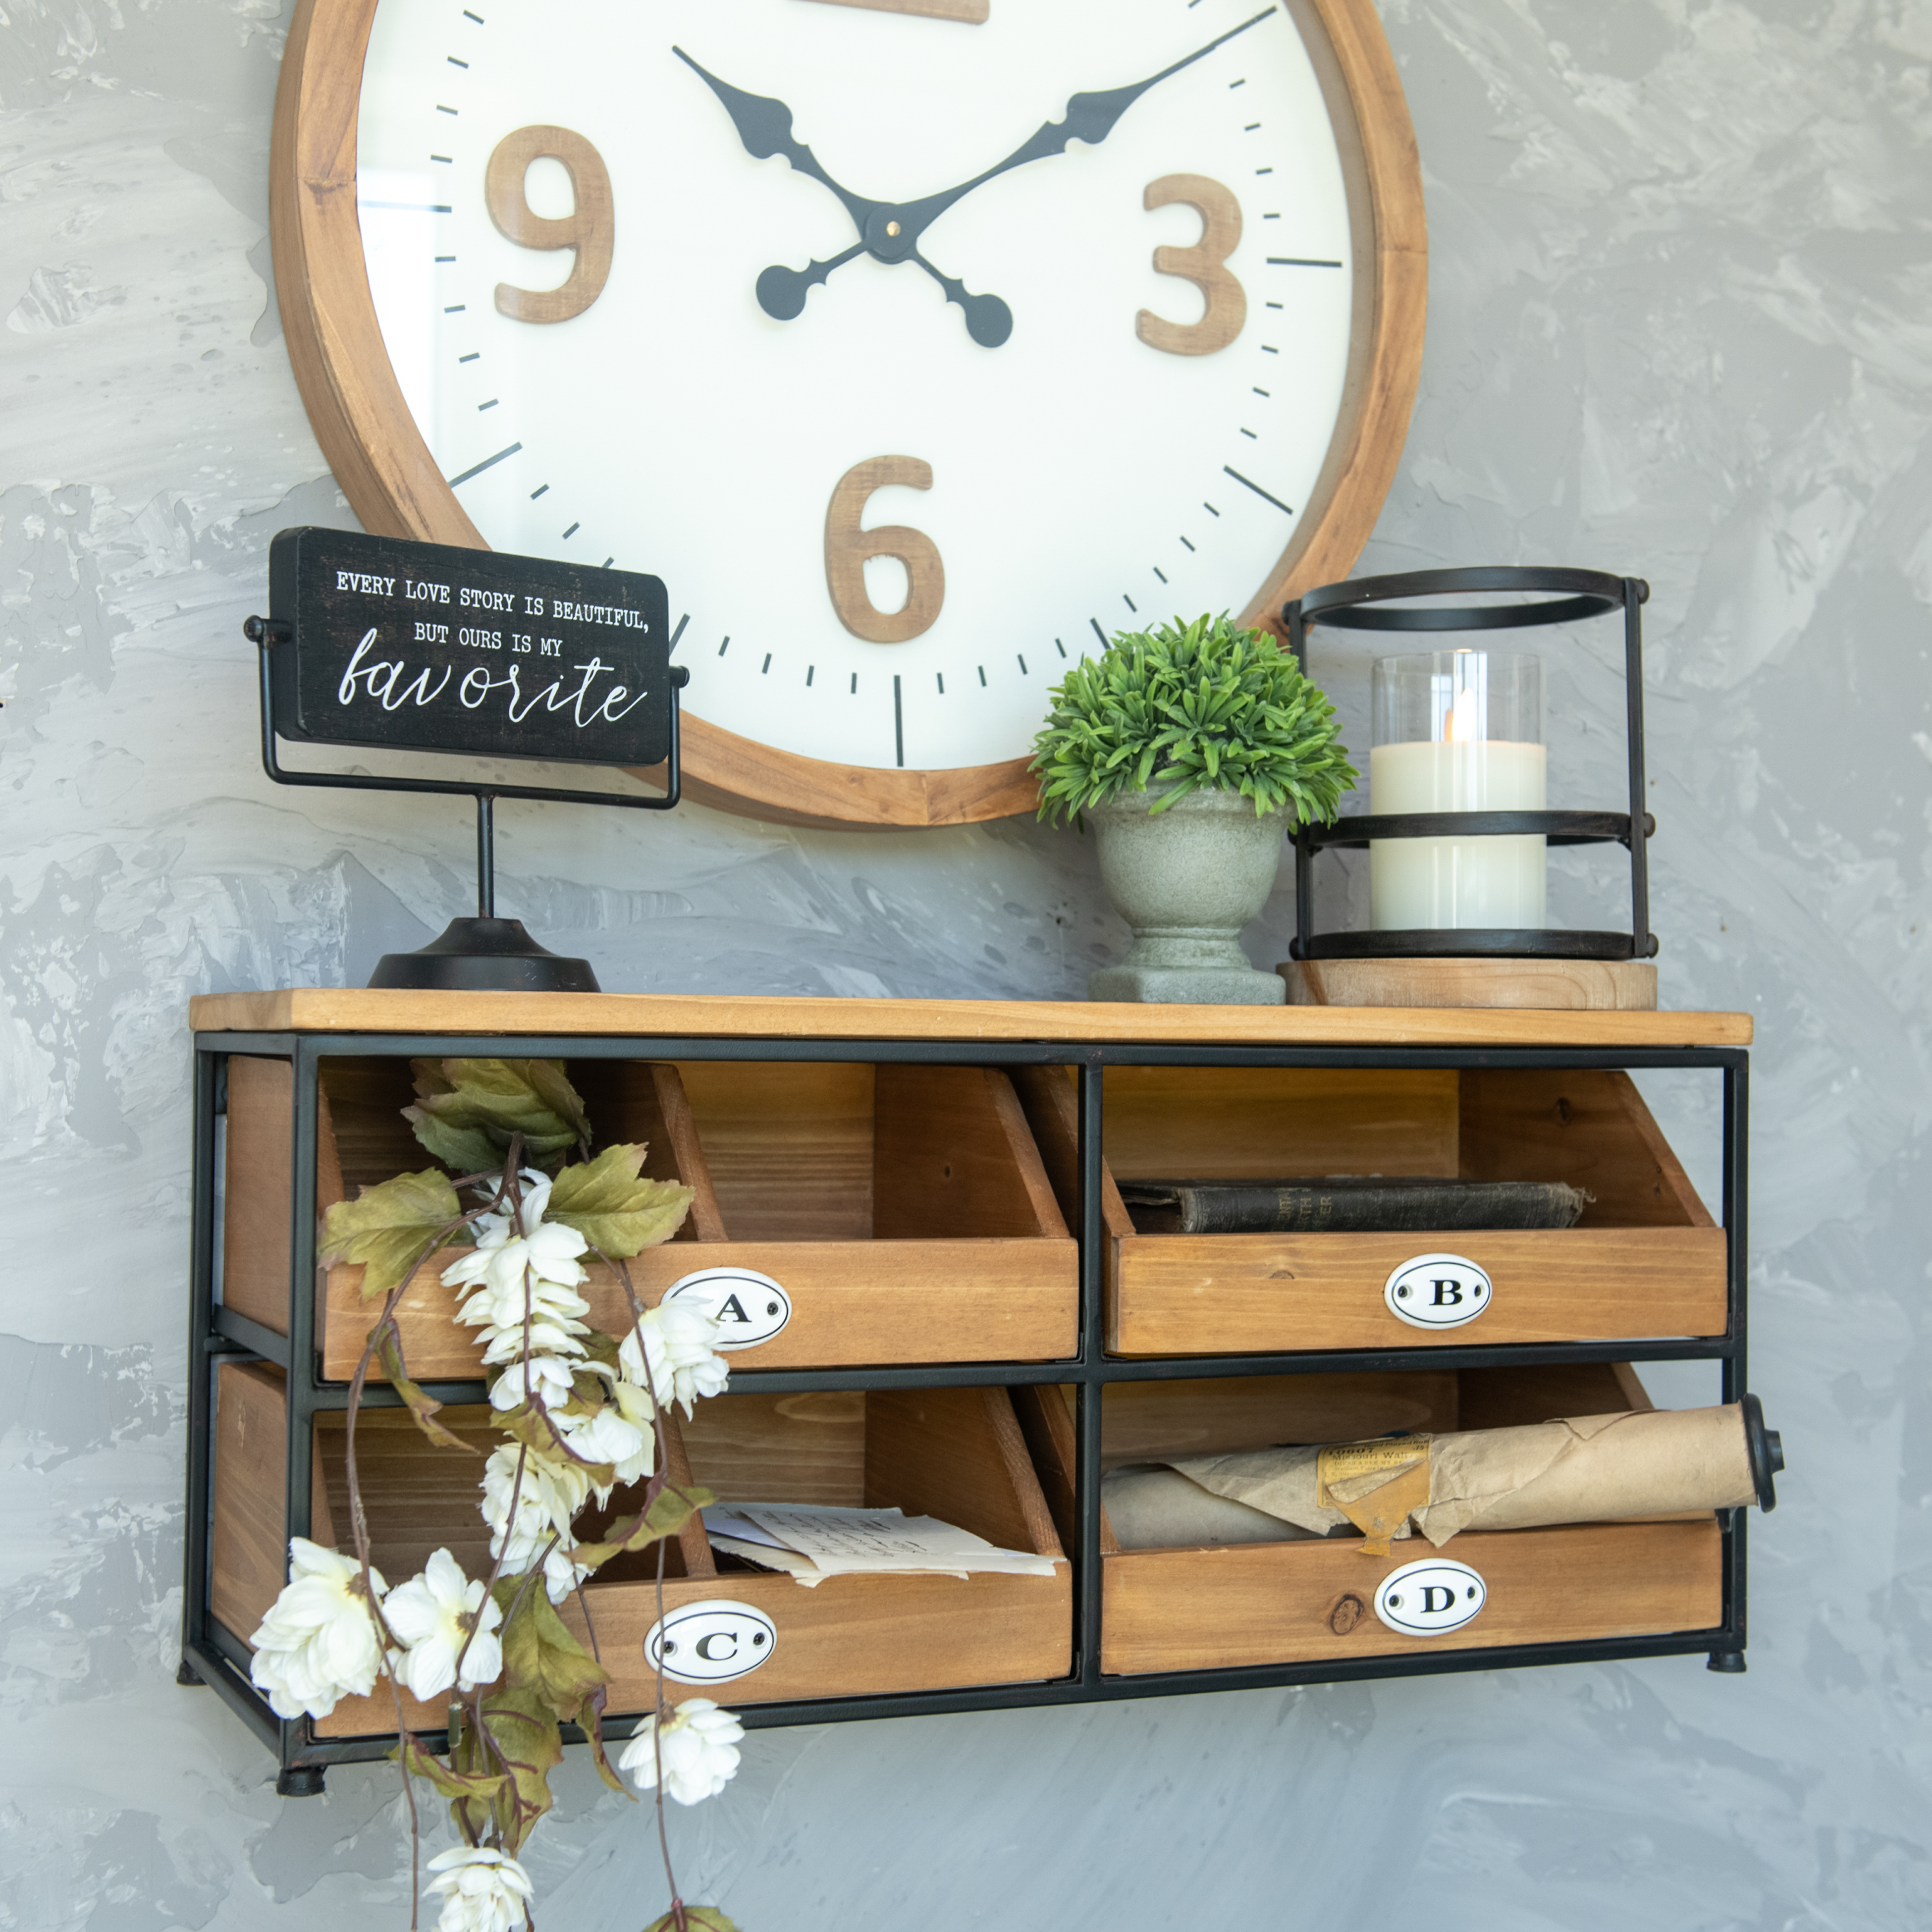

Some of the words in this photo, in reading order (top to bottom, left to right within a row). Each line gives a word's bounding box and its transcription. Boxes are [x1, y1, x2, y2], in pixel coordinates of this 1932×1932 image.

[484, 124, 616, 325] 9
[1135, 172, 1247, 357] 3
[823, 454, 945, 644] 6
[336, 571, 396, 596] EVERY
[405, 580, 450, 603] LOVE
[460, 588, 515, 612] STORY
[525, 597, 543, 616] IS
[553, 601, 649, 634] BEAUTIFUL,
[414, 622, 449, 644] BUT
[459, 629, 502, 650] OURS
[511, 634, 532, 653] IS
[540, 639, 563, 657] MY
[338, 628, 647, 727] favorite
[715, 1293, 752, 1323] A
[1429, 1280, 1463, 1306] B
[1332, 1452, 1378, 1461] Missouri
[1419, 1586, 1455, 1613] D
[696, 1632, 738, 1661] C
